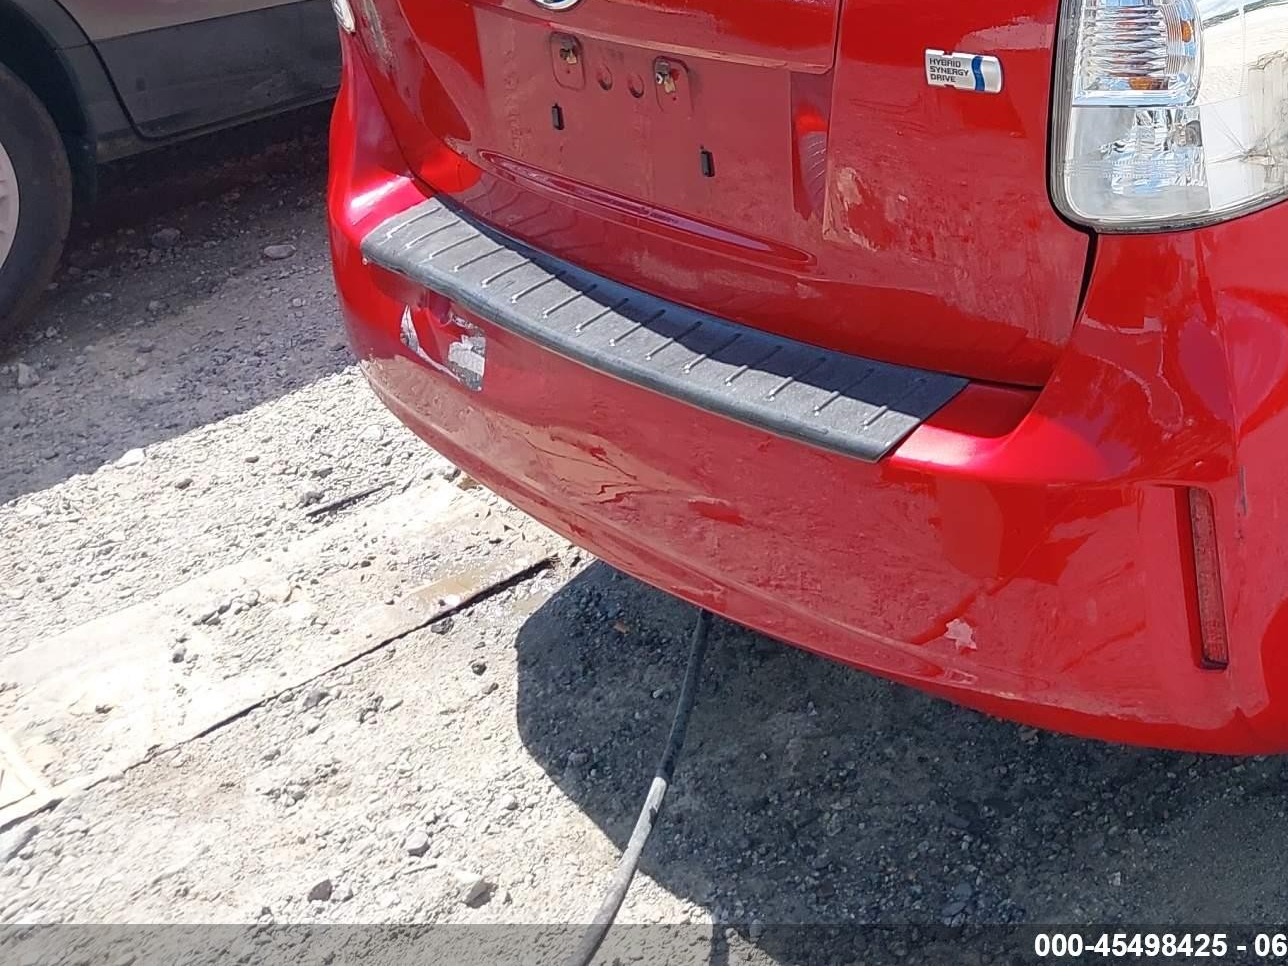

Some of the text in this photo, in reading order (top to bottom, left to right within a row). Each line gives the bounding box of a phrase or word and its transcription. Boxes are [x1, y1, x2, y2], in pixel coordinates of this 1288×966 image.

[929, 57, 961, 68] HYBRID
[929, 65, 969, 76] SYNERGY
[930, 73, 957, 83] DRIVE
